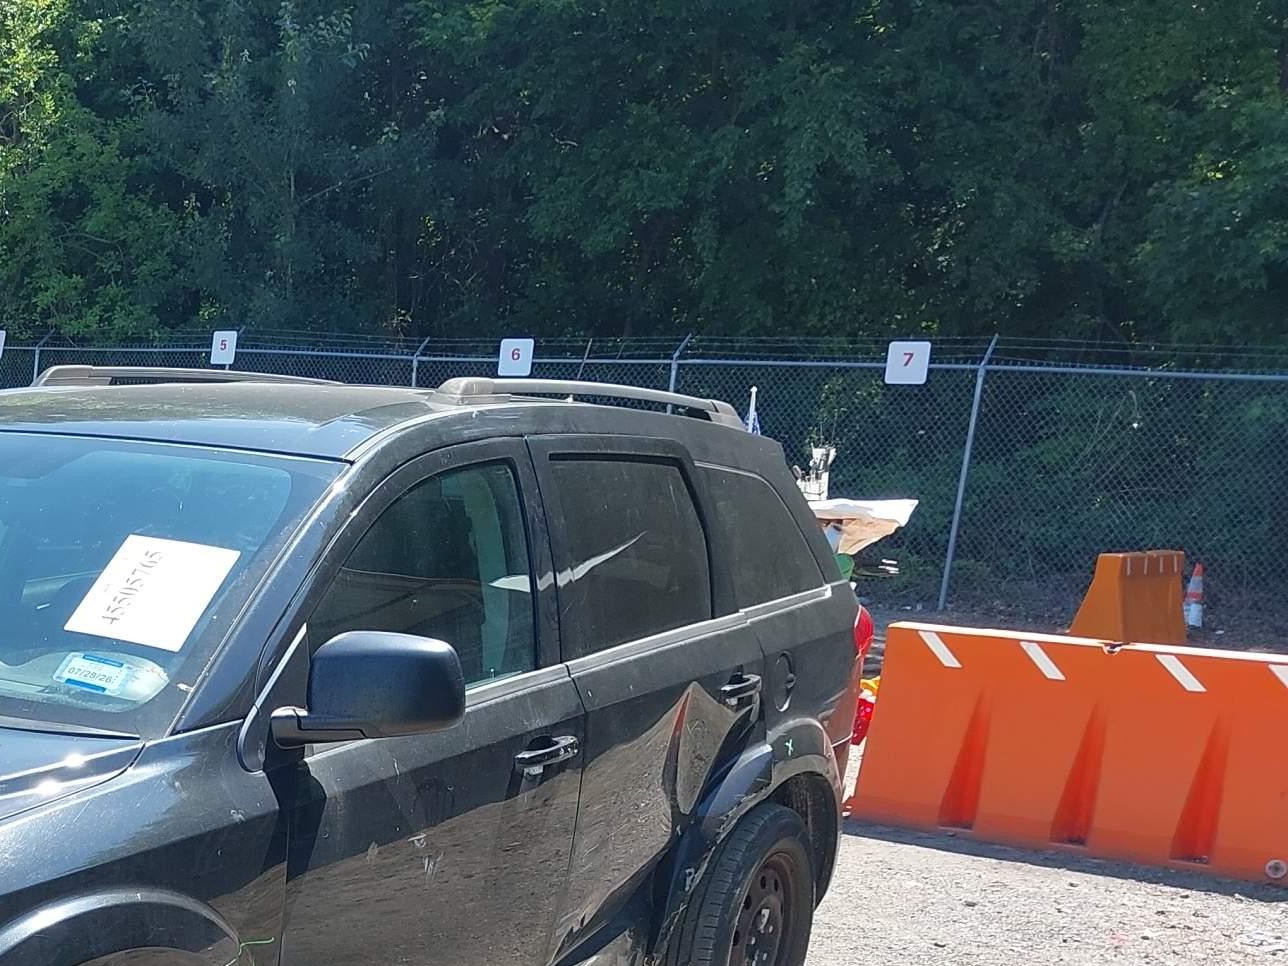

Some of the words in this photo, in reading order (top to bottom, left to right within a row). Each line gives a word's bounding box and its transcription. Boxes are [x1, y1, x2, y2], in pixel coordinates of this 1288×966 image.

[220, 339, 228, 351] 5
[511, 347, 521, 361] 6
[903, 352, 914, 367] 7
